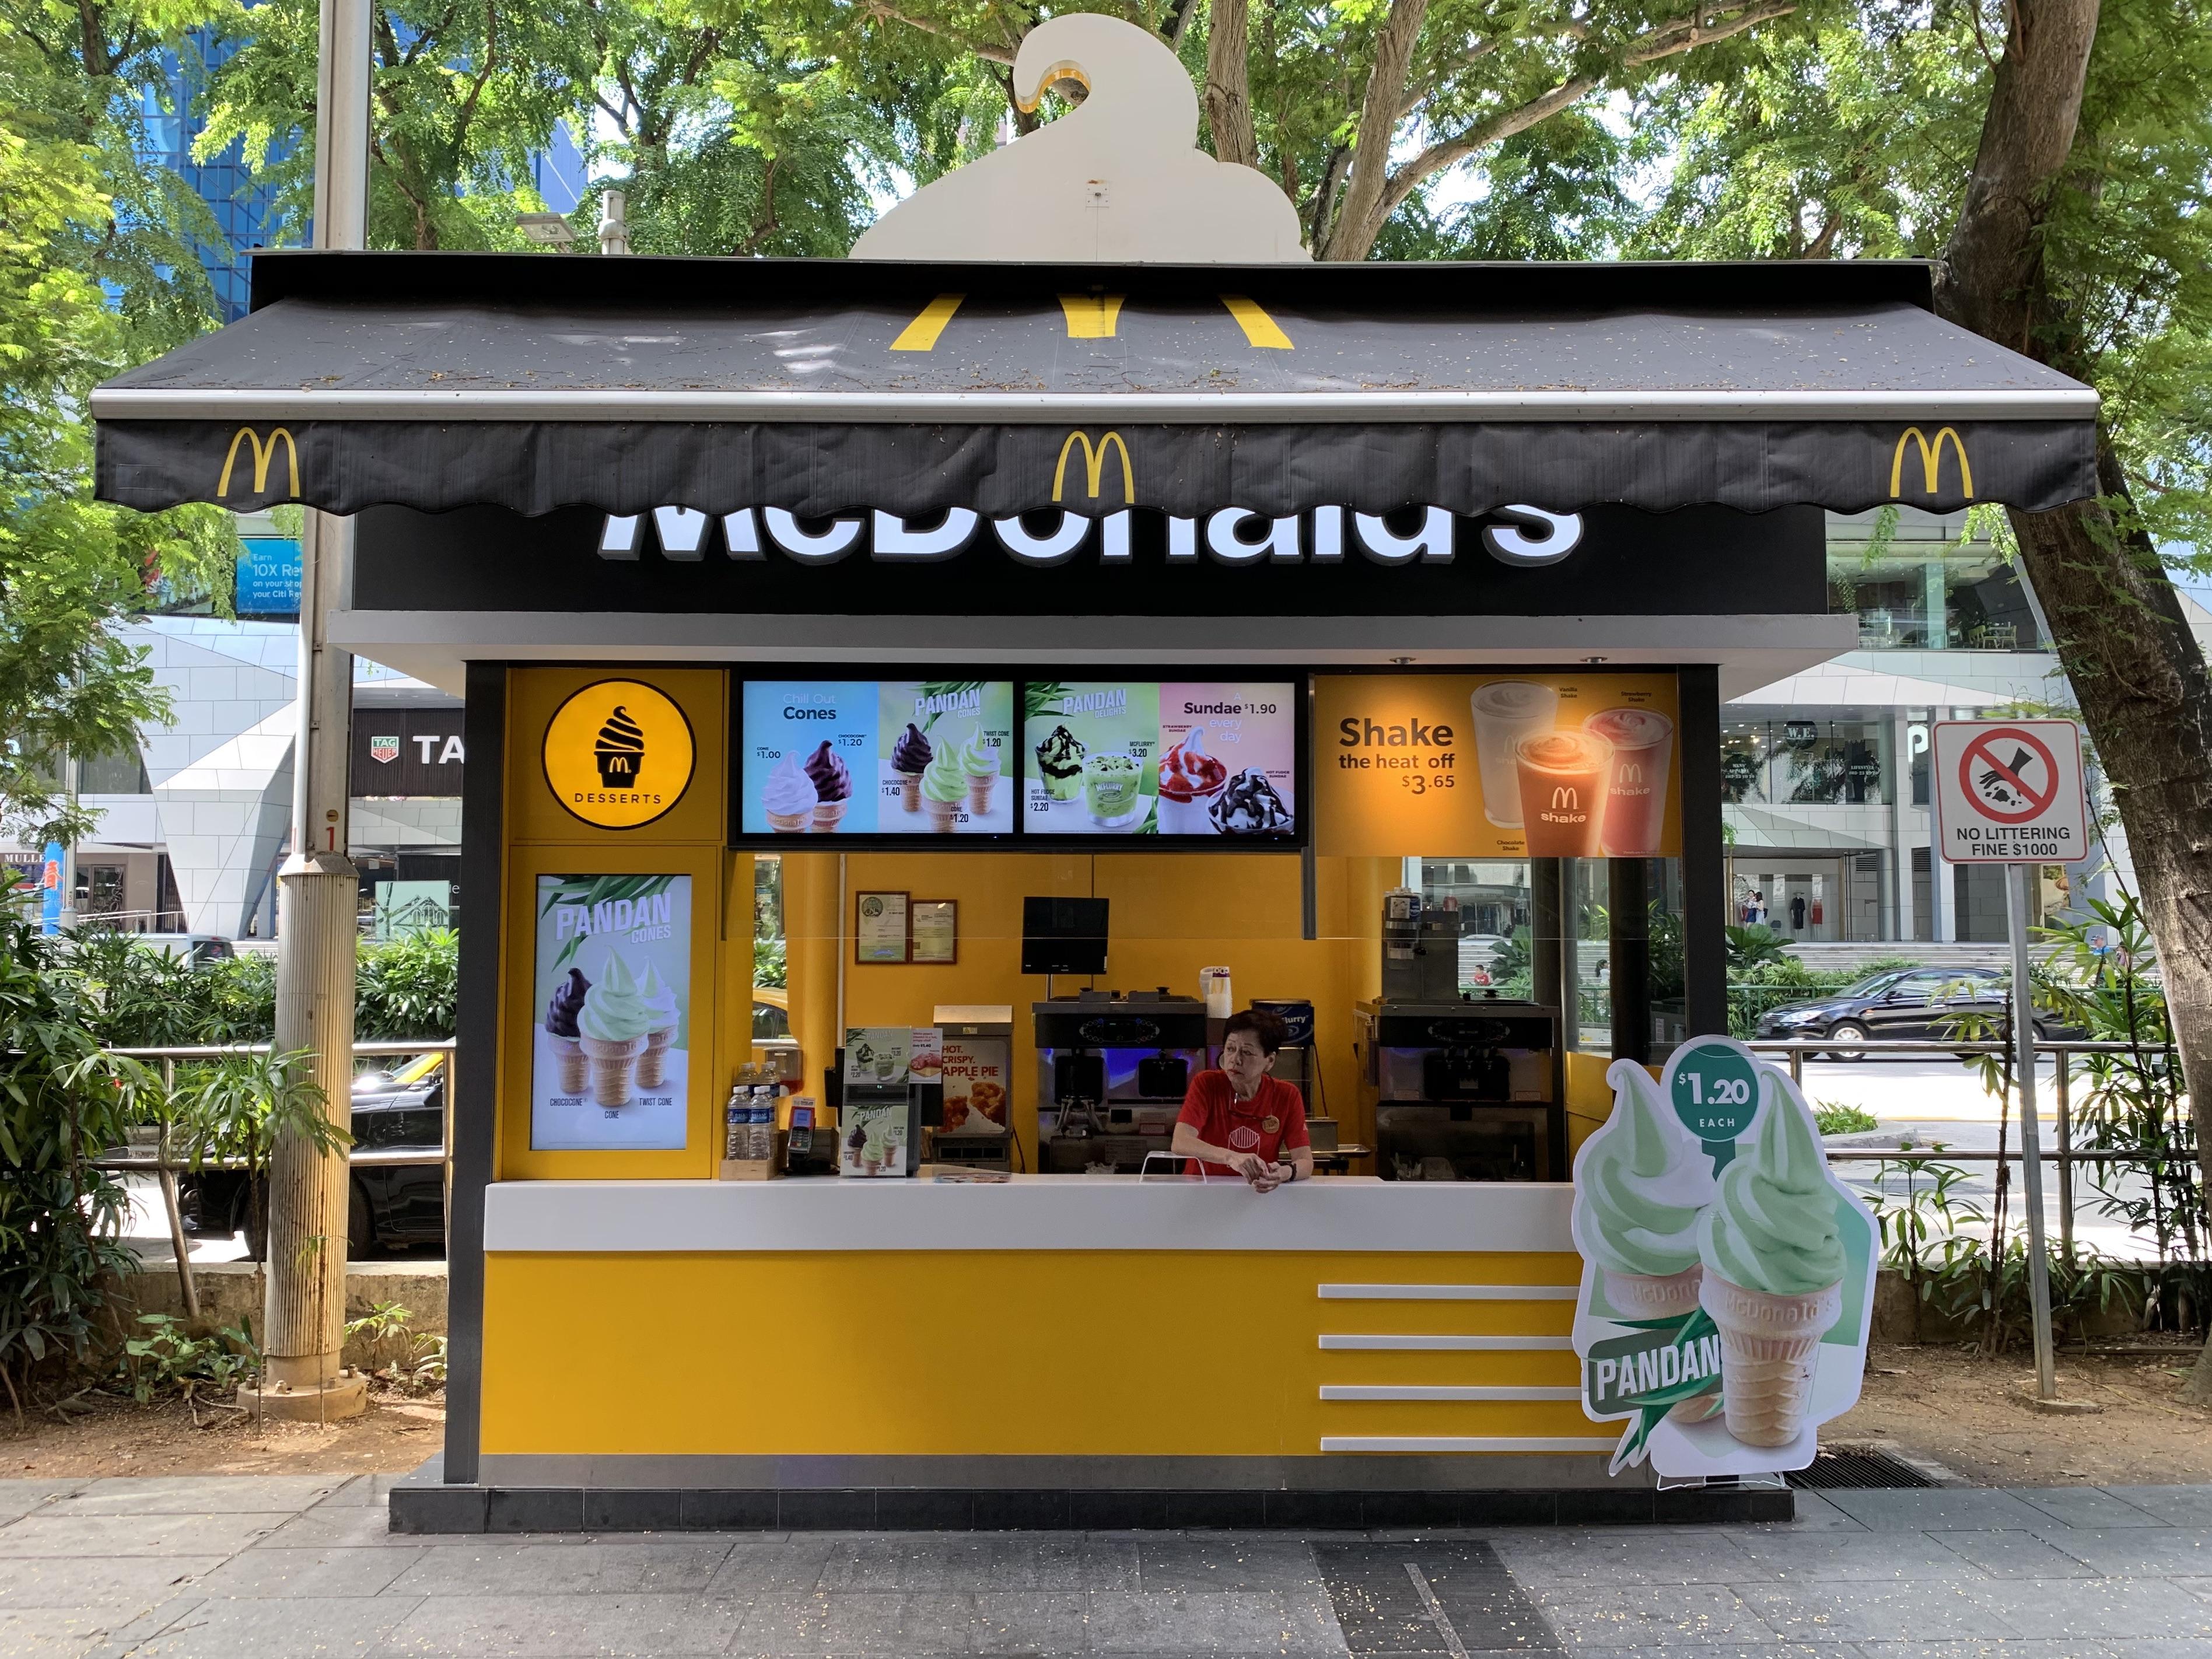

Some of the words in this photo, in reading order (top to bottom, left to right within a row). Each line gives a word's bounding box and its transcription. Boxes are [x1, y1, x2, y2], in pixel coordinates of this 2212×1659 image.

[600, 504, 1583, 559] conas
[253, 564, 278, 576] 10X
[783, 694, 808, 704] Chill
[813, 694, 835, 704] Out
[915, 689, 981, 716] PANDAN
[1063, 688, 1126, 715] PANDAN
[783, 706, 836, 720] Cones
[958, 707, 980, 718] CONES
[1094, 706, 1126, 719] DELIGHTS
[1184, 702, 1242, 714] Sundae
[1245, 704, 1276, 714] $1.90
[1209, 718, 1242, 730] every
[1220, 731, 1242, 744] day
[1339, 718, 1454, 747] Shake
[983, 738, 1001, 747] $1.20
[373, 748, 396, 760] HEUER
[412, 736, 464, 764] TA
[1129, 748, 1147, 757] $3.20
[1339, 754, 1371, 769] the
[1376, 754, 1419, 769] heat
[1428, 753, 1455, 769] off
[1402, 775, 1455, 794] $3.65
[881, 787, 900, 796] $1.40
[1609, 787, 1650, 796] shake
[575, 793, 661, 804] DESSERTS
[1030, 803, 1048, 811] $2.20
[950, 814, 968, 822] $1.20
[1541, 813, 1586, 823] shake
[326, 827, 334, 850] 1
[1957, 828, 1980, 840] NO
[1986, 827, 2070, 840] LITTERING
[1972, 844, 2008, 855] FINE
[2013, 843, 2057, 856] $1000
[555, 892, 671, 940] PANDAN
[631, 924, 671, 944] CONES
[942, 1045, 963, 1054] HOT.
[943, 1066, 978, 1076] APPLE
[982, 1066, 998, 1076] PIE
[1679, 1072, 1750, 1104] $1.20
[550, 1097, 583, 1106] CHOCOCONE
[639, 1097, 656, 1106] TWIST
[658, 1097, 672, 1106] CONE
[604, 1111, 619, 1119] CONE
[860, 1107, 891, 1121] PANDAN
[1699, 1118, 1735, 1127] EACH
[1726, 1290, 1833, 1322] McDonald's
[1597, 1334, 1720, 1401] PANDAN
